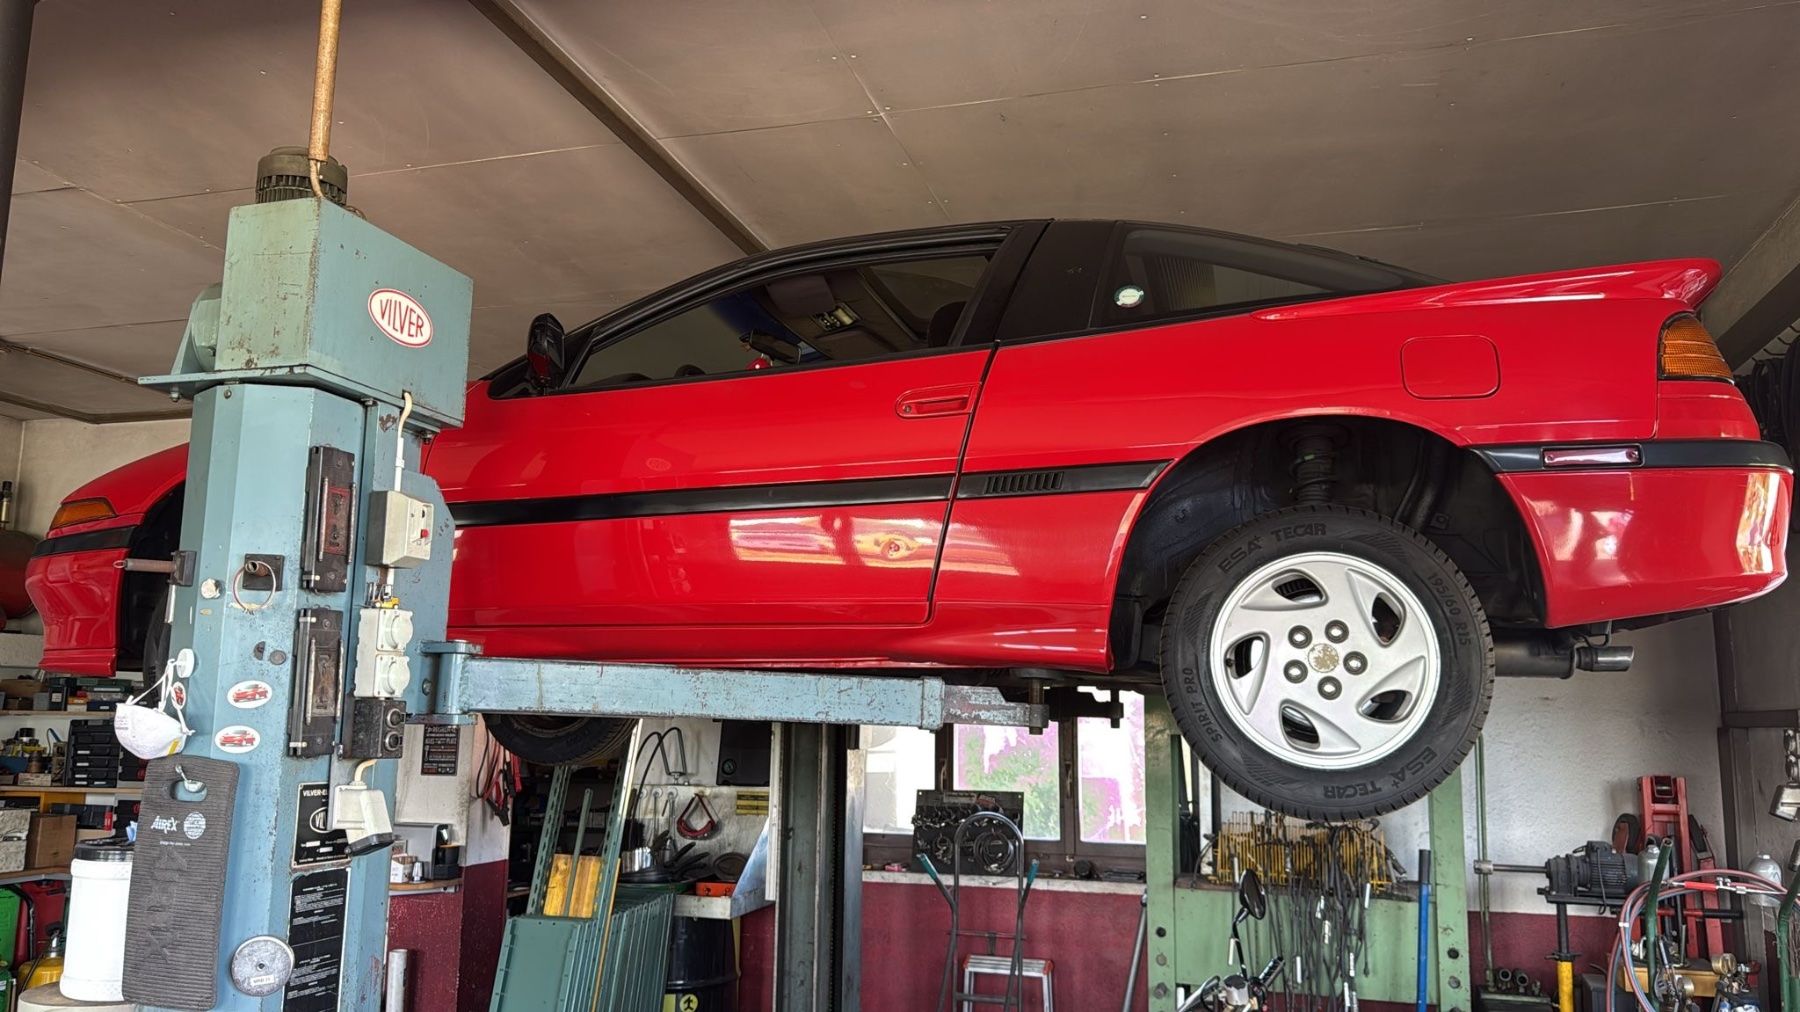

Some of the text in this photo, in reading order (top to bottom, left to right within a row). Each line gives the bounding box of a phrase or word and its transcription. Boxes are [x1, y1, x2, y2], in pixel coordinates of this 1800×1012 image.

[379, 298, 425, 338] VILVER
[1271, 522, 1327, 542] TECAR
[1427, 572, 1472, 646] 195/60 R15
[1183, 667, 1223, 742] SPIRIT PRO
[1322, 780, 1382, 799] TECAR
[150, 815, 178, 835] AIREX
